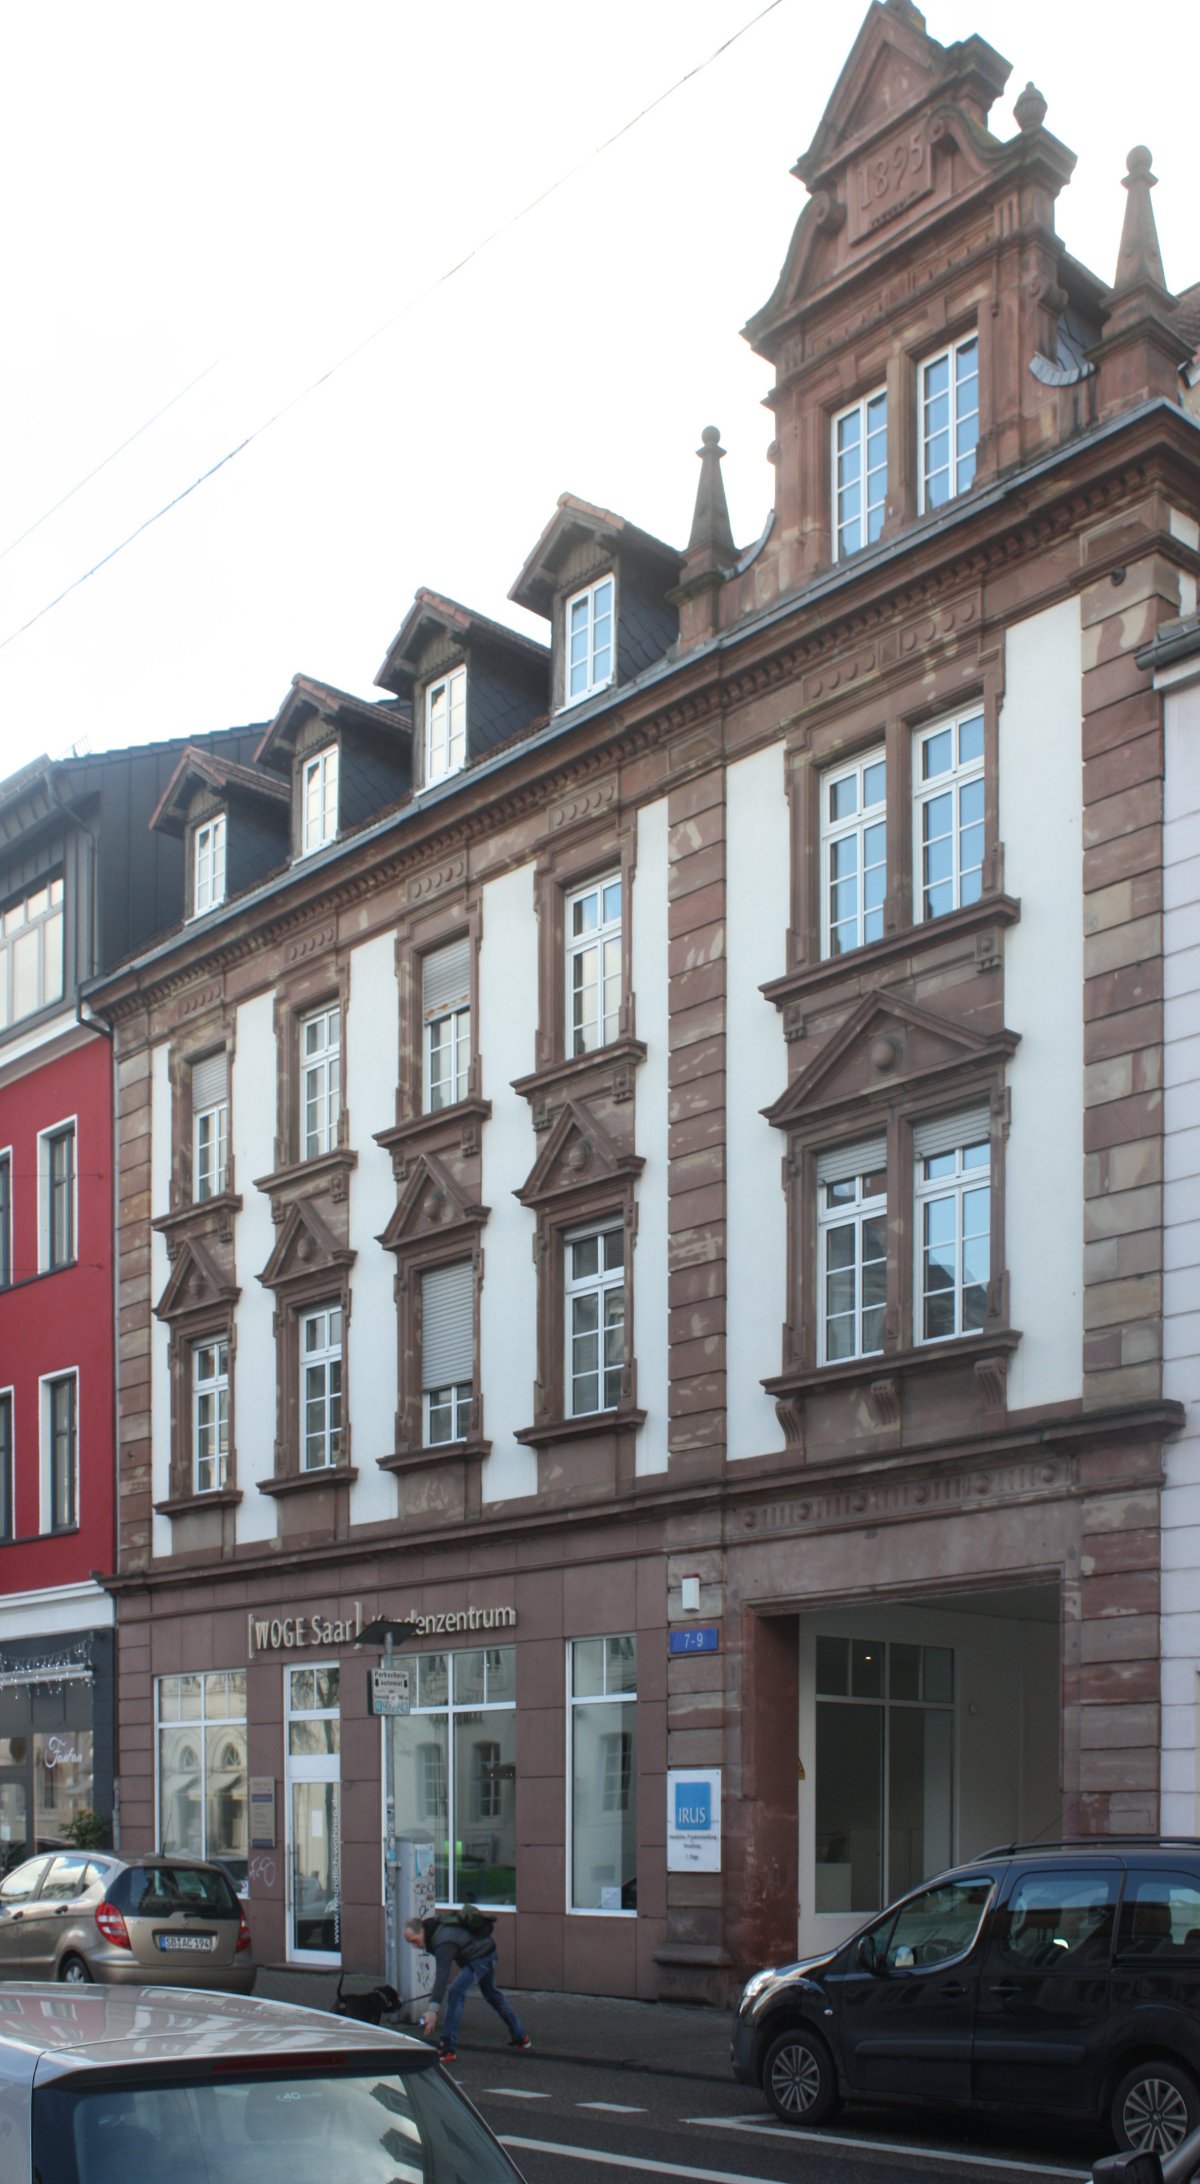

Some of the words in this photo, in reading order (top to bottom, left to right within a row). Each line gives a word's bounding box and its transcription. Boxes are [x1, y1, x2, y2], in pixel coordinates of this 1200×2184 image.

[859, 132, 925, 211] 1895
[684, 1632, 703, 1648] 7-9
[679, 1807, 706, 1824] IRUS
[166, 1938, 176, 1948] SB
[182, 1938, 192, 1948] AC
[195, 1938, 209, 1948] 194
